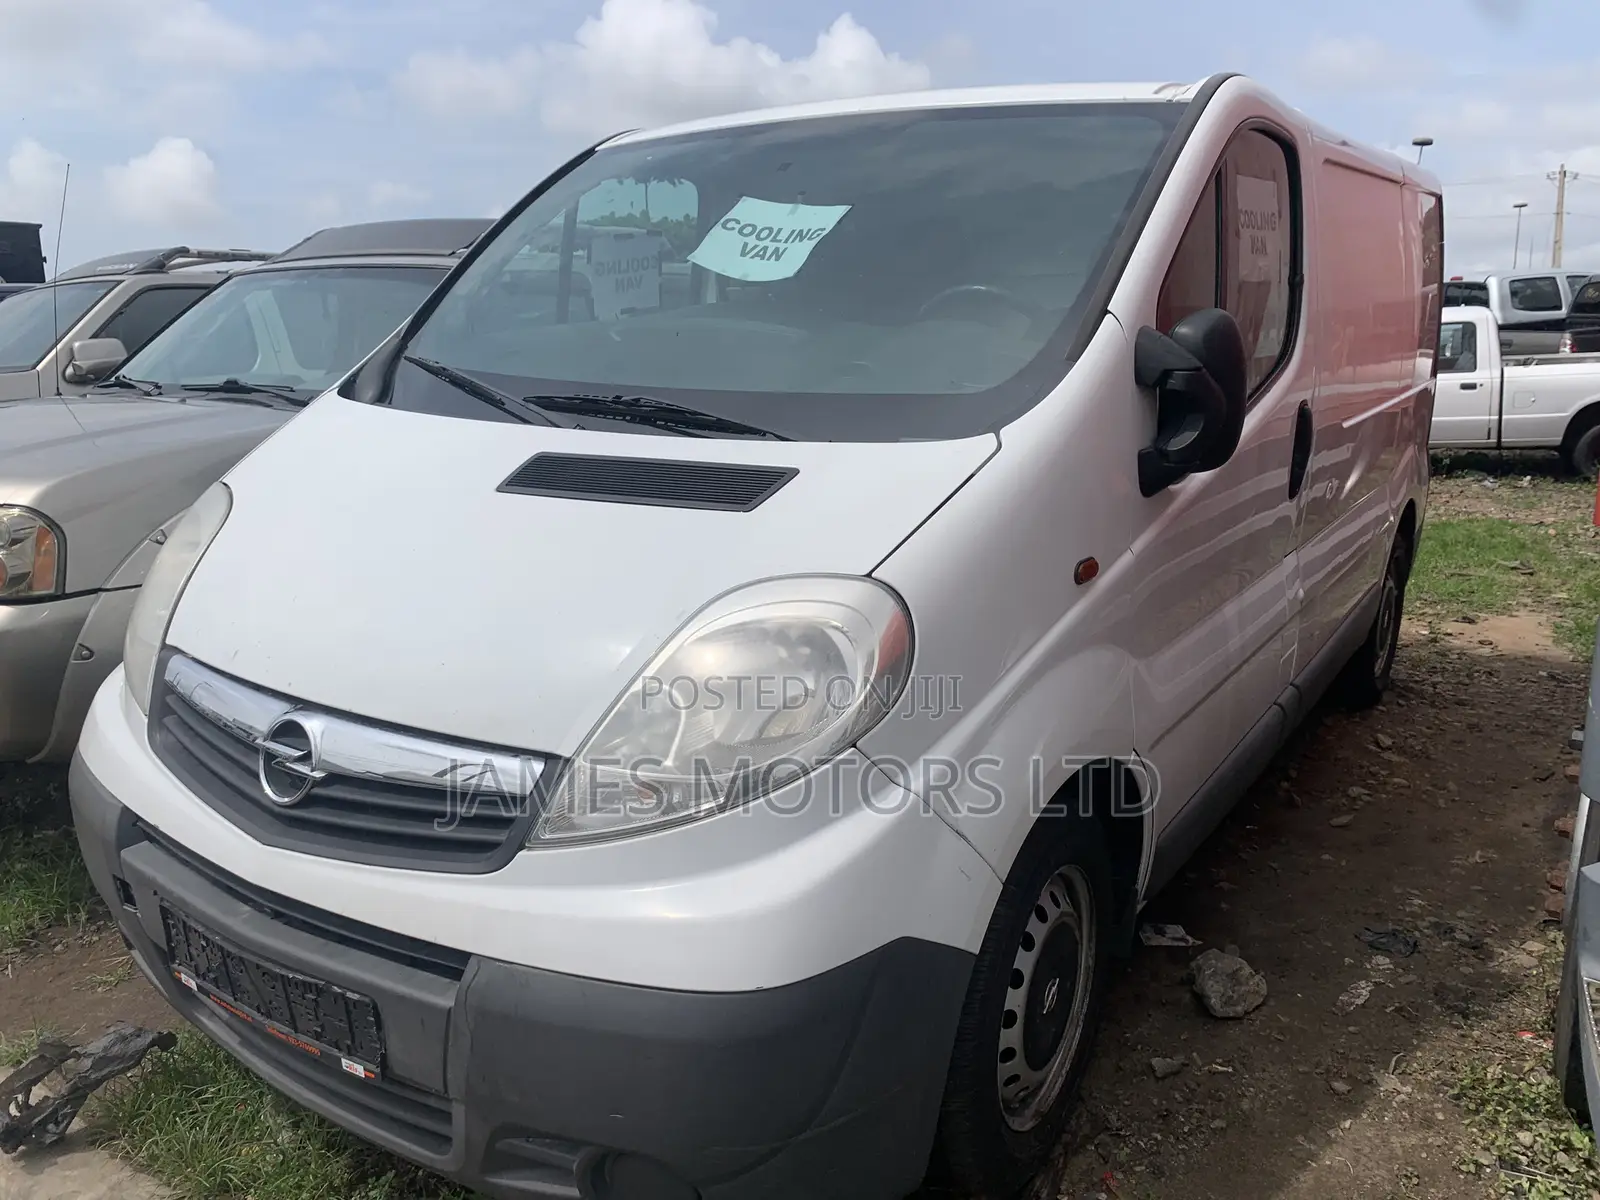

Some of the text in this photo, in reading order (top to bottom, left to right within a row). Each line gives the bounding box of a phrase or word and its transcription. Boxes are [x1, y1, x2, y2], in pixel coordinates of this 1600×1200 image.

[720, 217, 826, 245] COOLING
[1240, 209, 1277, 231] COOLING
[739, 241, 789, 263] VAN
[1249, 235, 1268, 255] VAN
